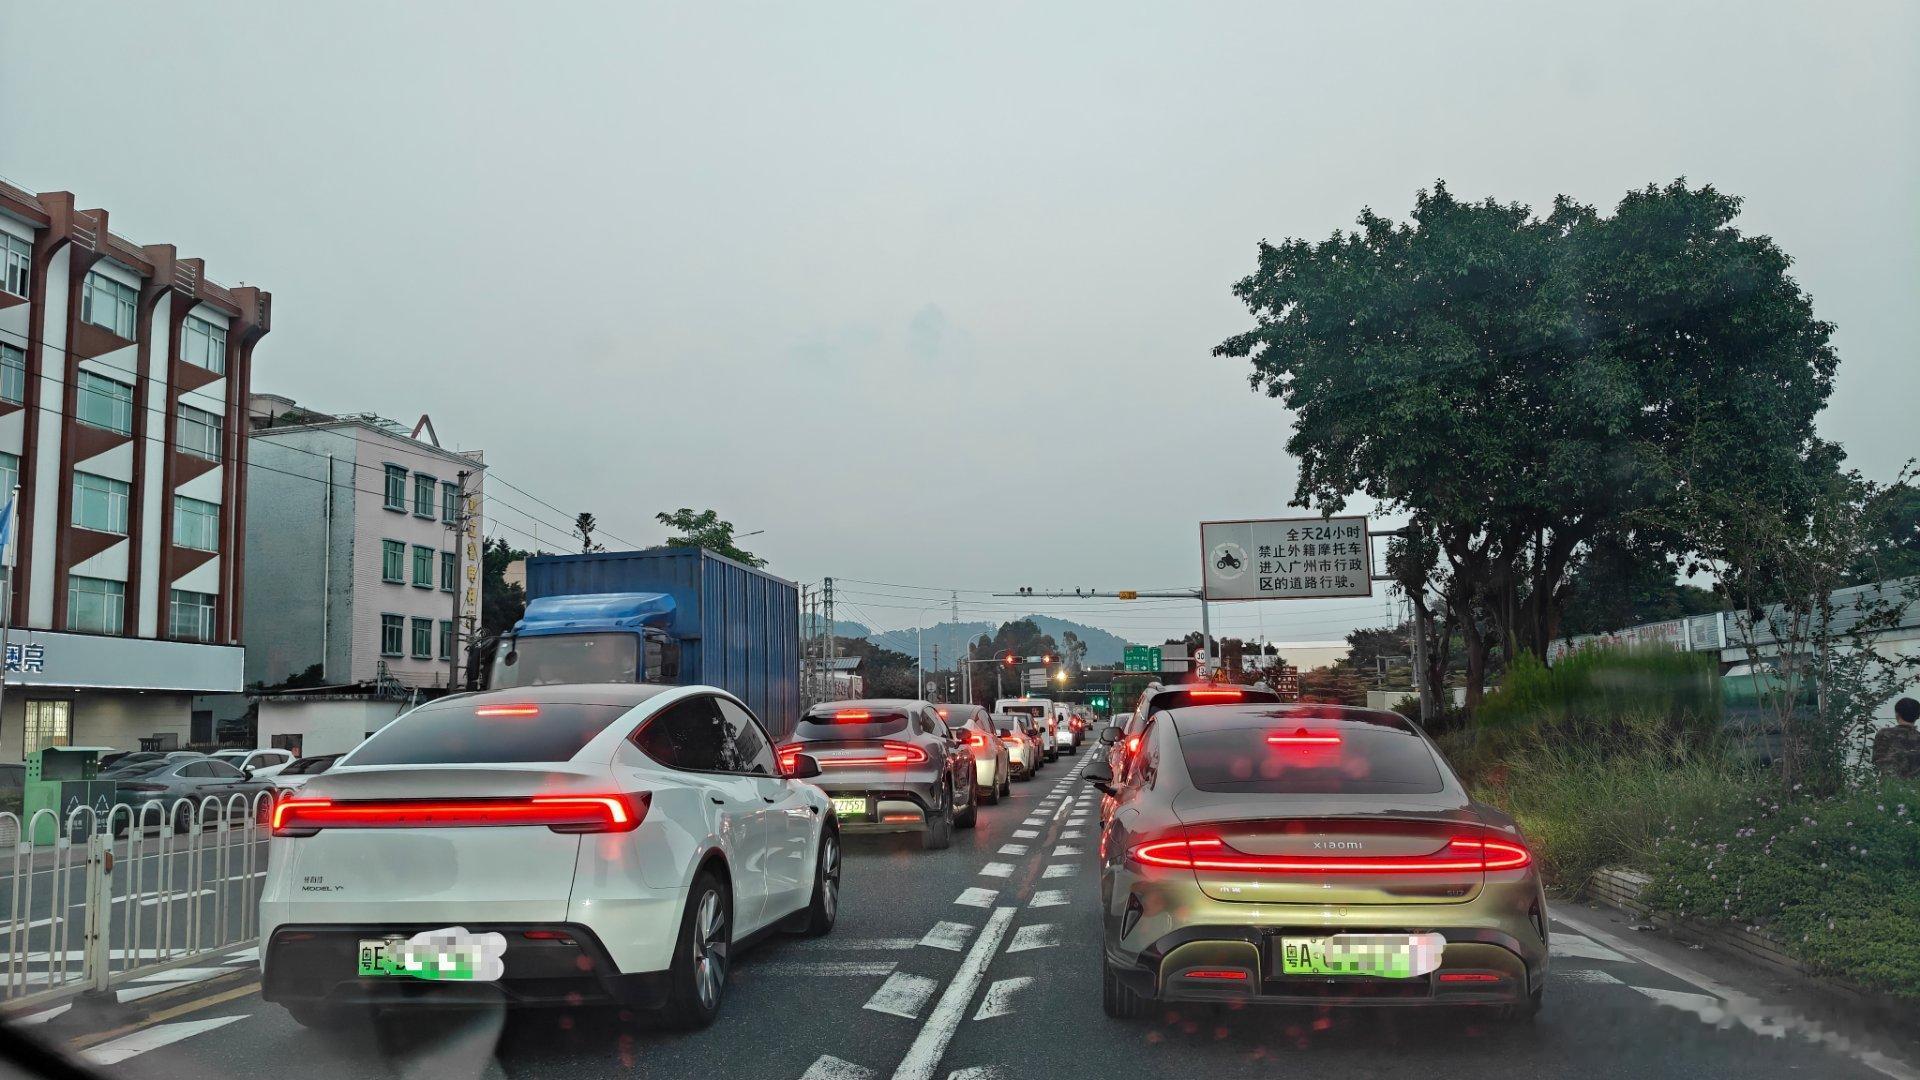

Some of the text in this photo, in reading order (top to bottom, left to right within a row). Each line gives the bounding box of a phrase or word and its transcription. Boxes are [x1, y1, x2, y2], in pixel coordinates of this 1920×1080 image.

[1286, 526, 1360, 542] 全天24小时
[1258, 542, 1362, 558] 禁止外籍摩托车
[1259, 559, 1363, 574] 进入广州市行政
[1259, 575, 1356, 591] 区的道路行驶。
[1313, 841, 1363, 849] xiaomi
